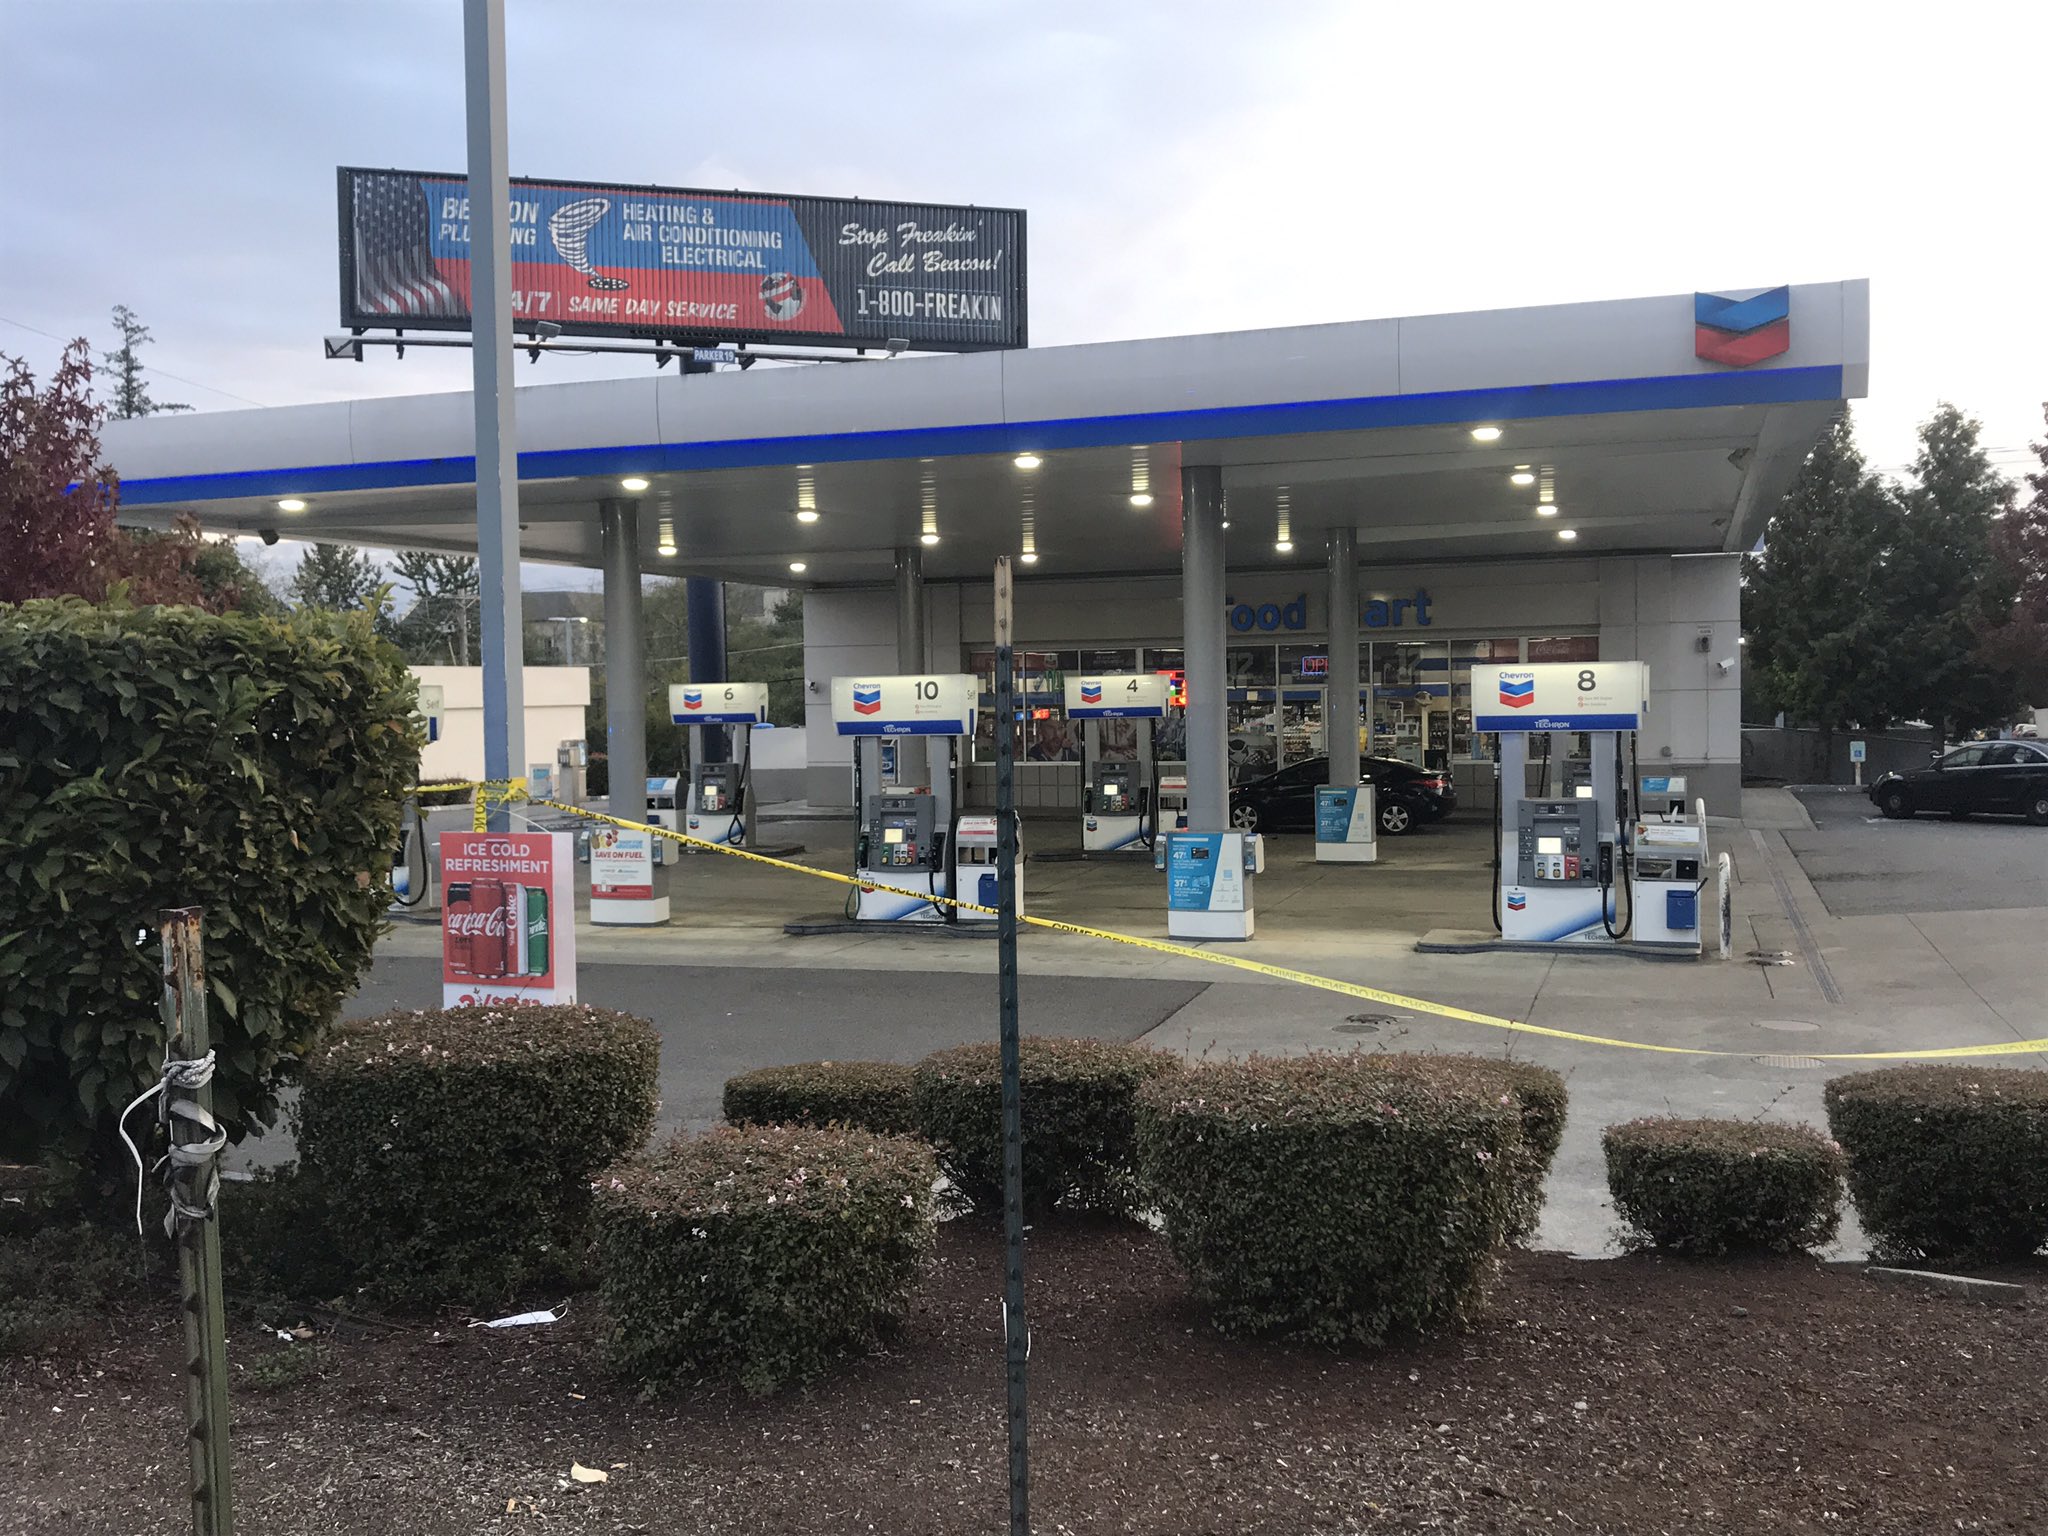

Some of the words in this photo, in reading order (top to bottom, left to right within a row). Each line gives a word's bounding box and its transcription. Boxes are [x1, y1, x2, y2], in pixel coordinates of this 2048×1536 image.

[441, 197, 539, 224] BEON
[623, 203, 697, 224] HEATING
[702, 208, 714, 225] &
[623, 223, 652, 242] AIR
[659, 225, 783, 249] CONDITIONING
[838, 223, 889, 246] Stop
[662, 246, 766, 269] ELECTRICAL
[866, 252, 915, 277] Call
[922, 249, 1002, 273] Beacon!
[511, 290, 552, 314] 4/7
[568, 296, 620, 314] SAME
[625, 299, 660, 316] DAY
[665, 300, 738, 320] SERVICE
[857, 288, 1002, 322] 1-800-FREAKIN
[694, 350, 724, 362] PARKER
[724, 352, 735, 362] 19
[1226, 593, 1307, 632] ood
[1364, 591, 1432, 628] art
[1126, 679, 1138, 693] 4
[1499, 671, 1534, 679] Chevron
[1577, 670, 1596, 691] 8
[724, 687, 734, 700] 6
[914, 681, 939, 700] 10
[1534, 720, 1570, 729] TECHRON
[463, 843, 487, 856] ICE
[490, 843, 530, 857] COLD
[445, 858, 549, 874] REFRESHMENT
